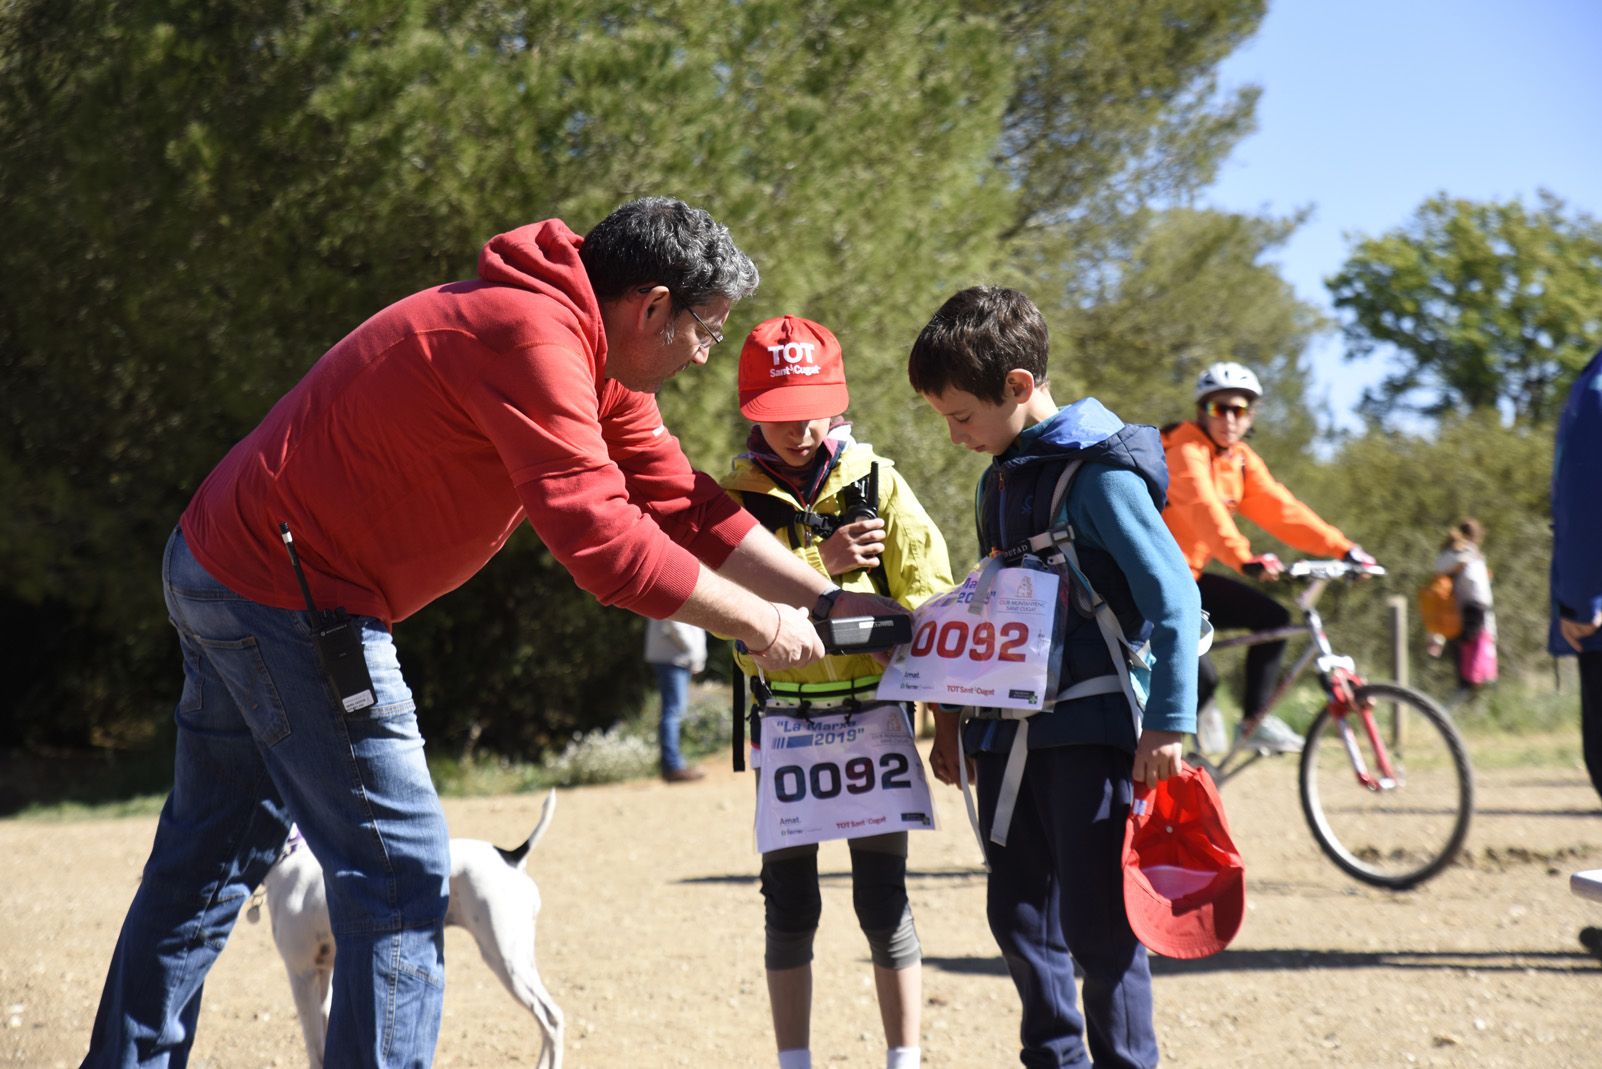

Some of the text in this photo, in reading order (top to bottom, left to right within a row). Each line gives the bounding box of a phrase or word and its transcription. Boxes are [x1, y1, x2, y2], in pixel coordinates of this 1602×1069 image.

[768, 342, 815, 366] TOT
[769, 366, 790, 378] Sant
[910, 619, 1029, 663] 0092
[774, 752, 911, 803] 0092
